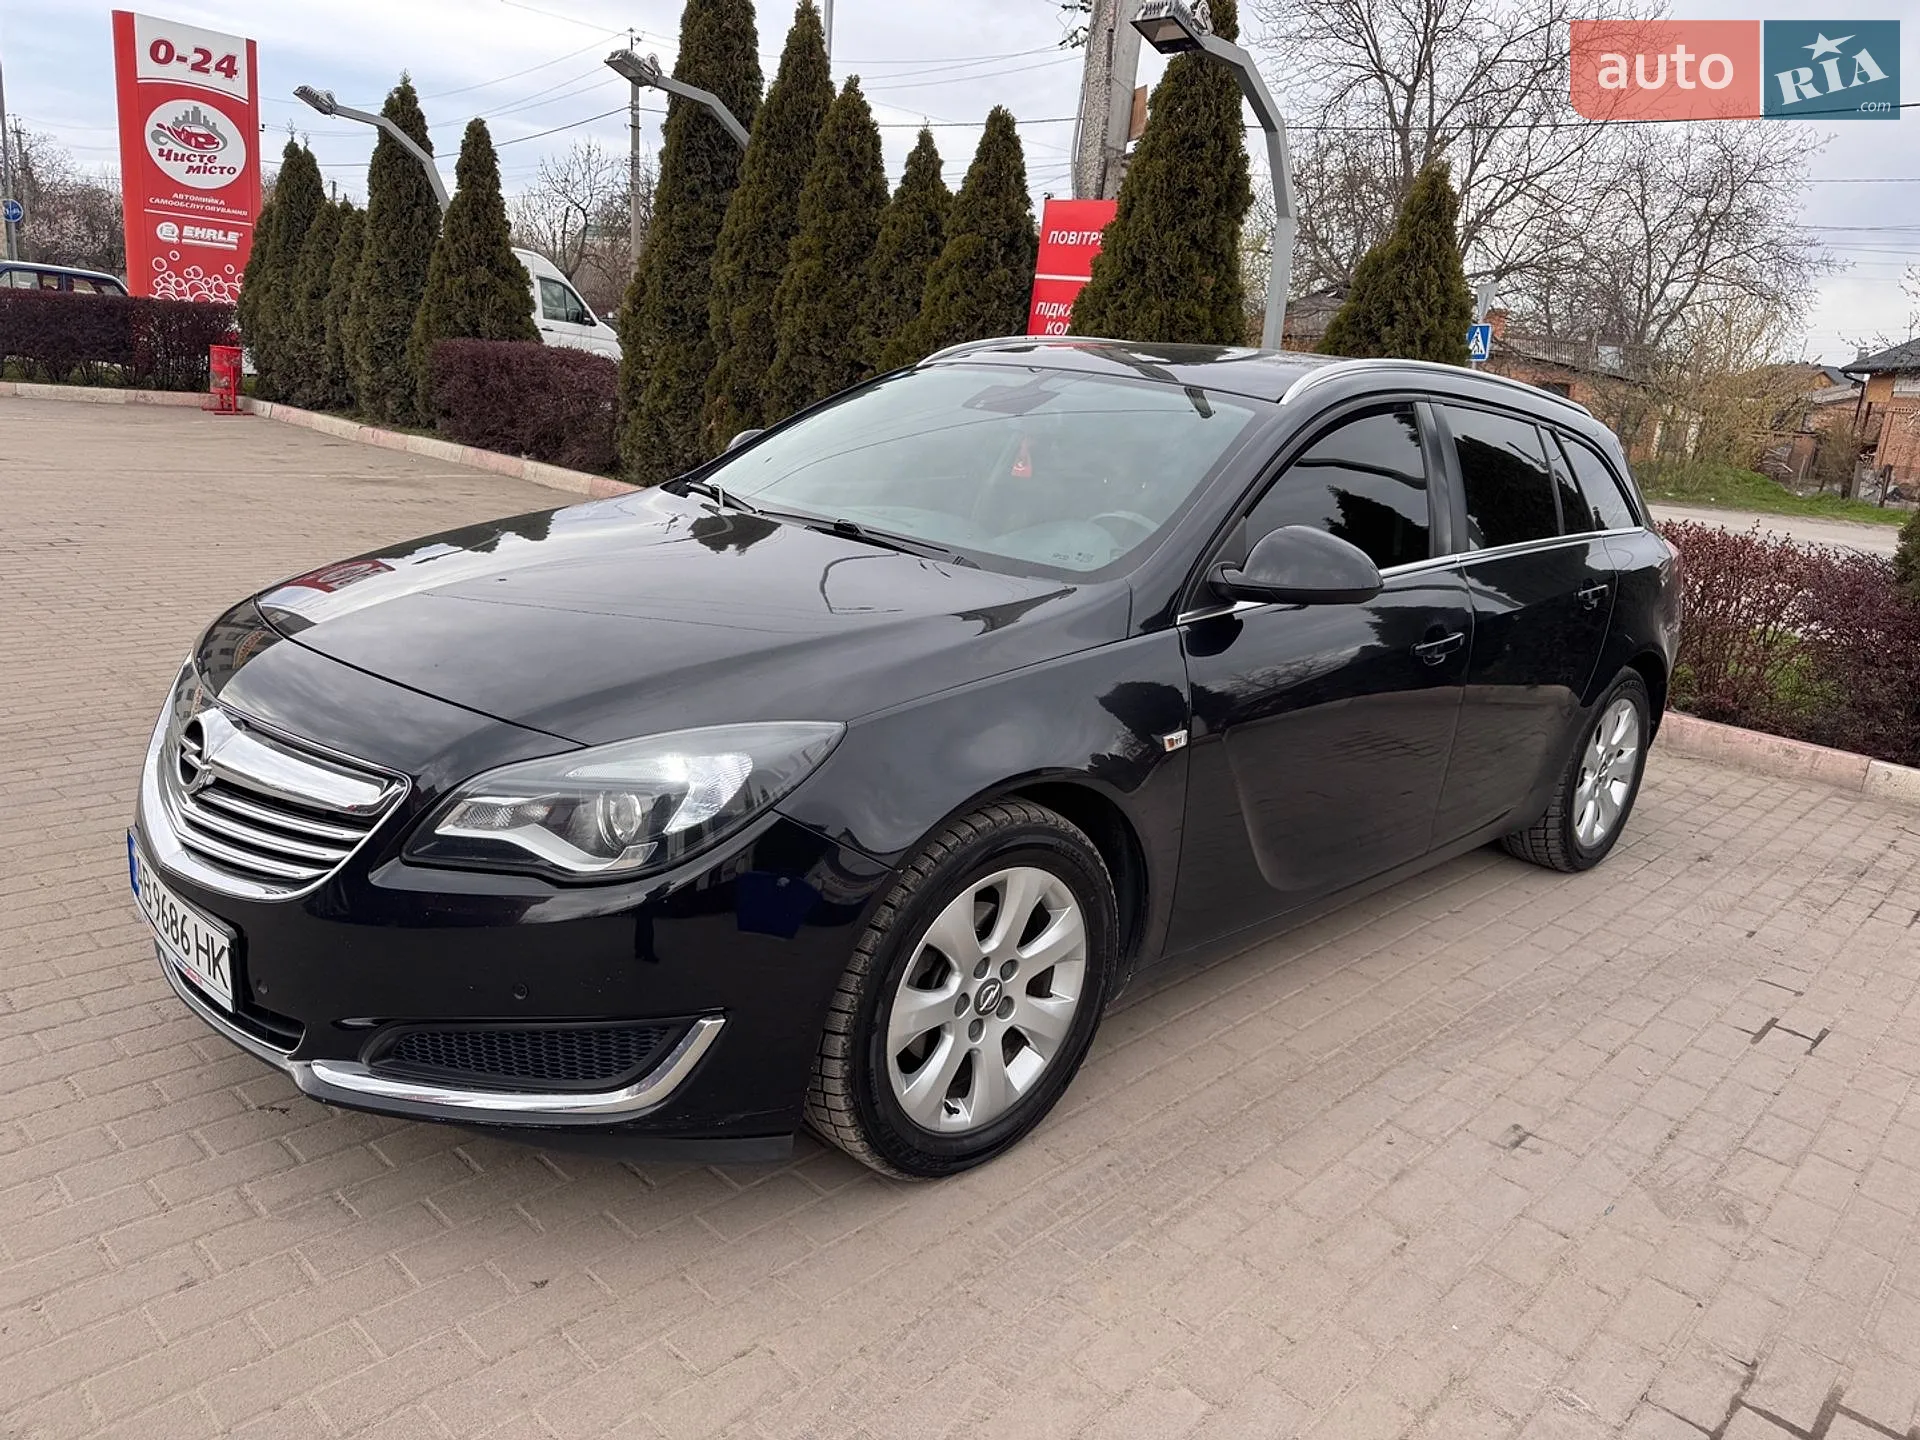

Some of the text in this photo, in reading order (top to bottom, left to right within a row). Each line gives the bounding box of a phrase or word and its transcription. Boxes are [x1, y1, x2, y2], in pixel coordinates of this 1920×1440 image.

[149, 38, 238, 79] 0-24
[157, 147, 218, 164] Чисте
[185, 162, 237, 175] місто
[182, 225, 239, 244] EHRLE
[153, 881, 191, 956] 9686
[195, 923, 229, 991] HK
